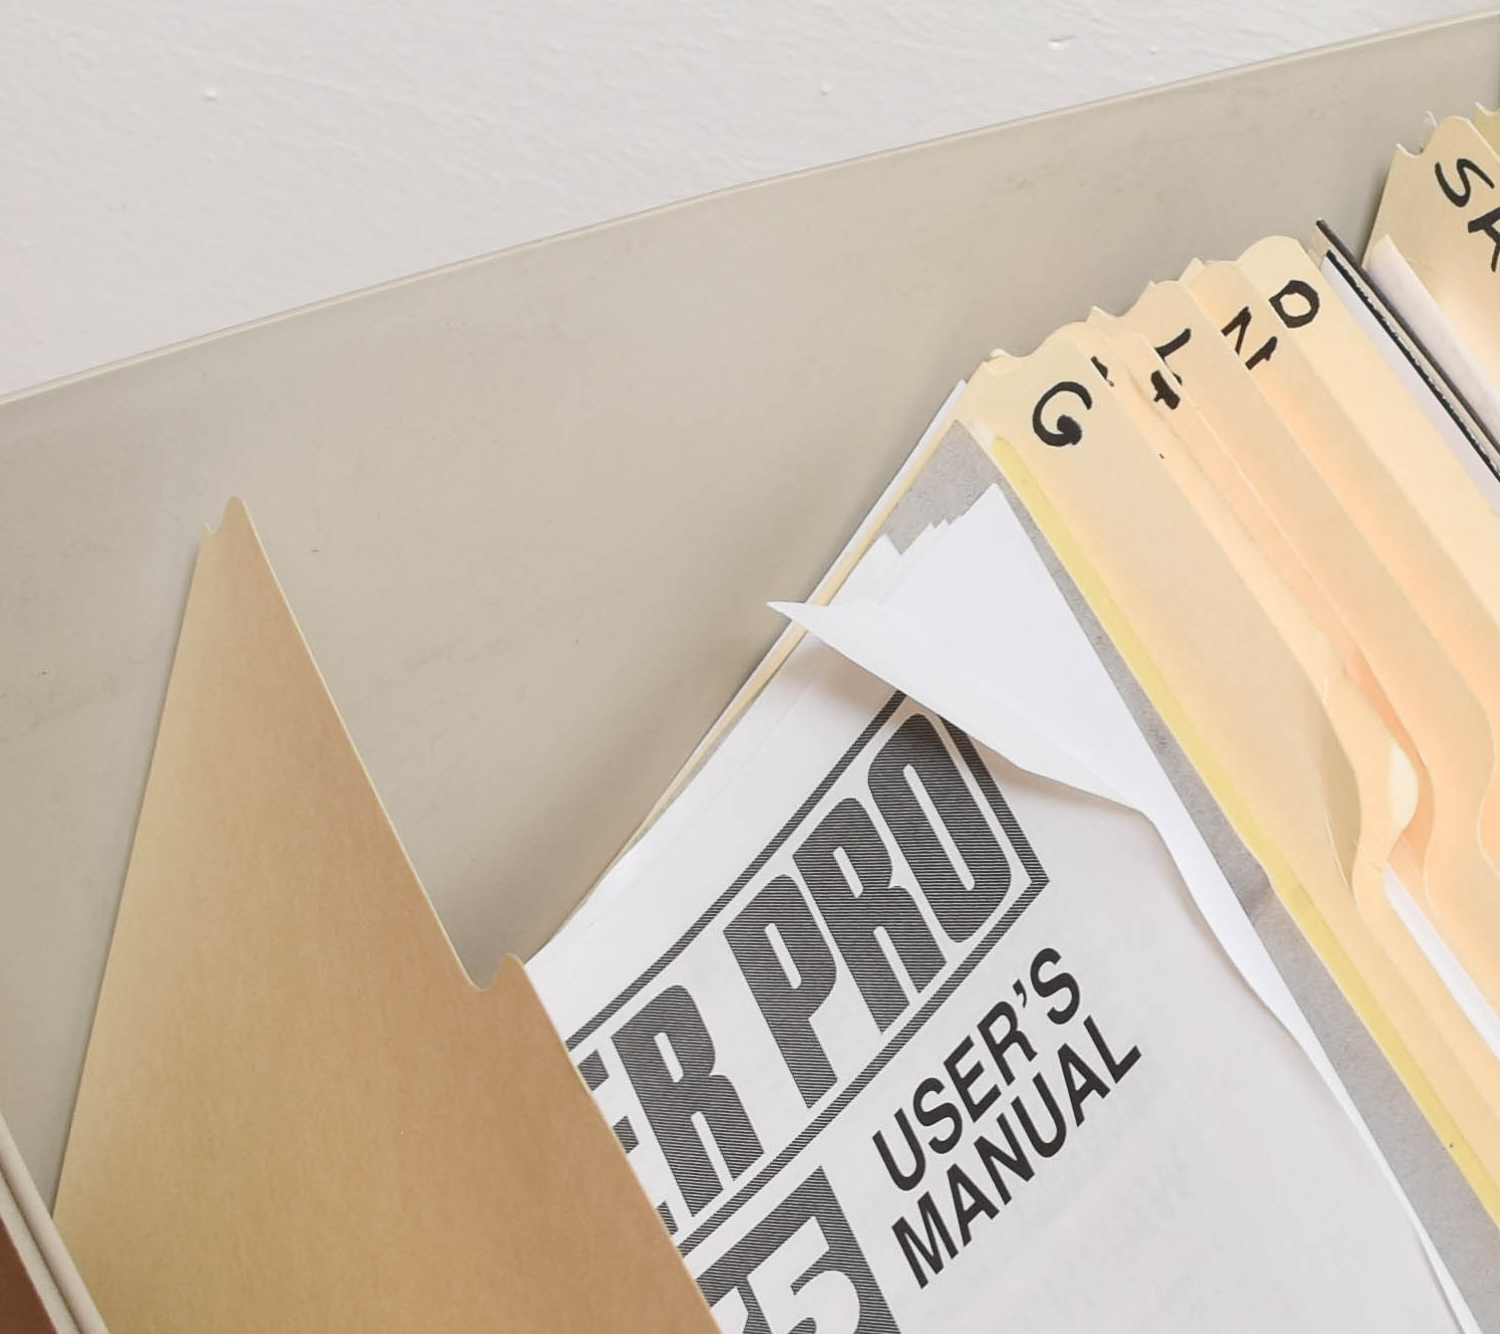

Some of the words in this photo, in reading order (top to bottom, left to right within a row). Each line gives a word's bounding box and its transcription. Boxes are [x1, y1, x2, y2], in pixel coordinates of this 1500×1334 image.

[1032, 381, 1092, 447] G
[722, 713, 1013, 1109] PRO
[872, 947, 1082, 1191] USER'S
[891, 1016, 1143, 1289] MANUAL
